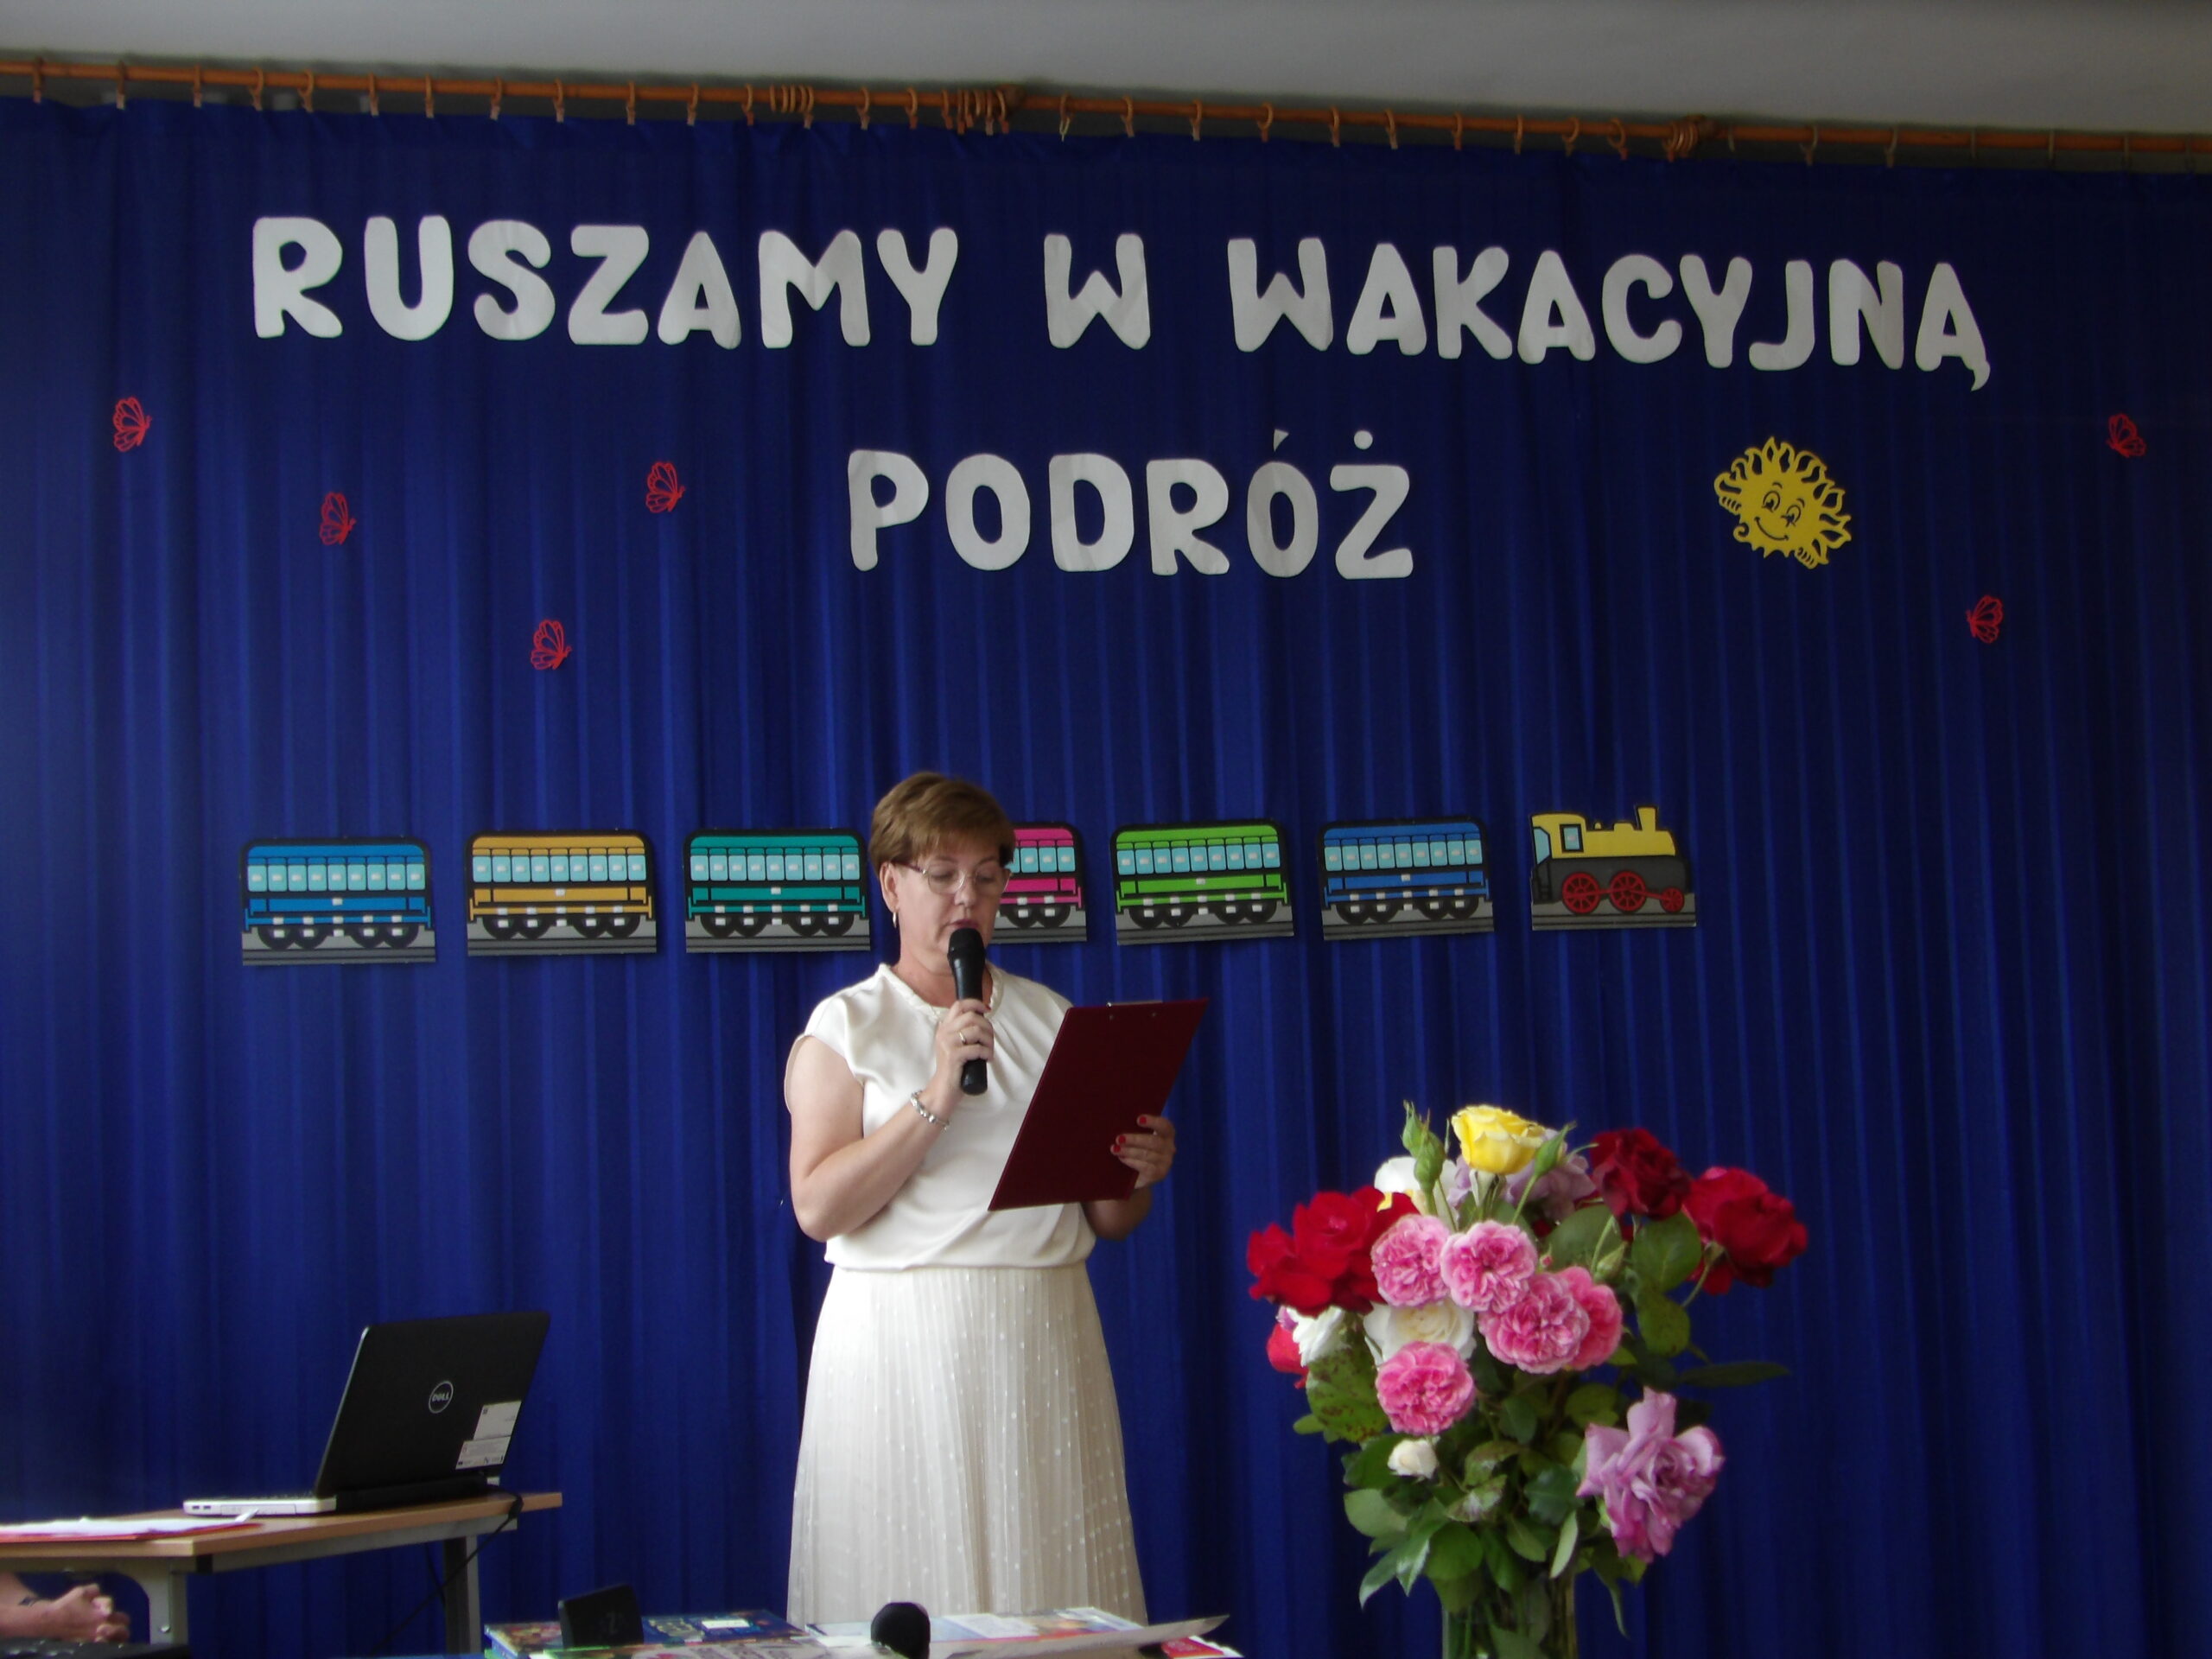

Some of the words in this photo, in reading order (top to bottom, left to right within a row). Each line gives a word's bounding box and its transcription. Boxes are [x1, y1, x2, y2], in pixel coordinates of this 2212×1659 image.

[253, 216, 959, 349] RUSZAMY
[1043, 233, 1152, 350] W
[1227, 237, 1991, 390] WAKACYJNĄ
[847, 429, 1414, 580] PODRÓŻ
[431, 1392, 450, 1403] DELL
